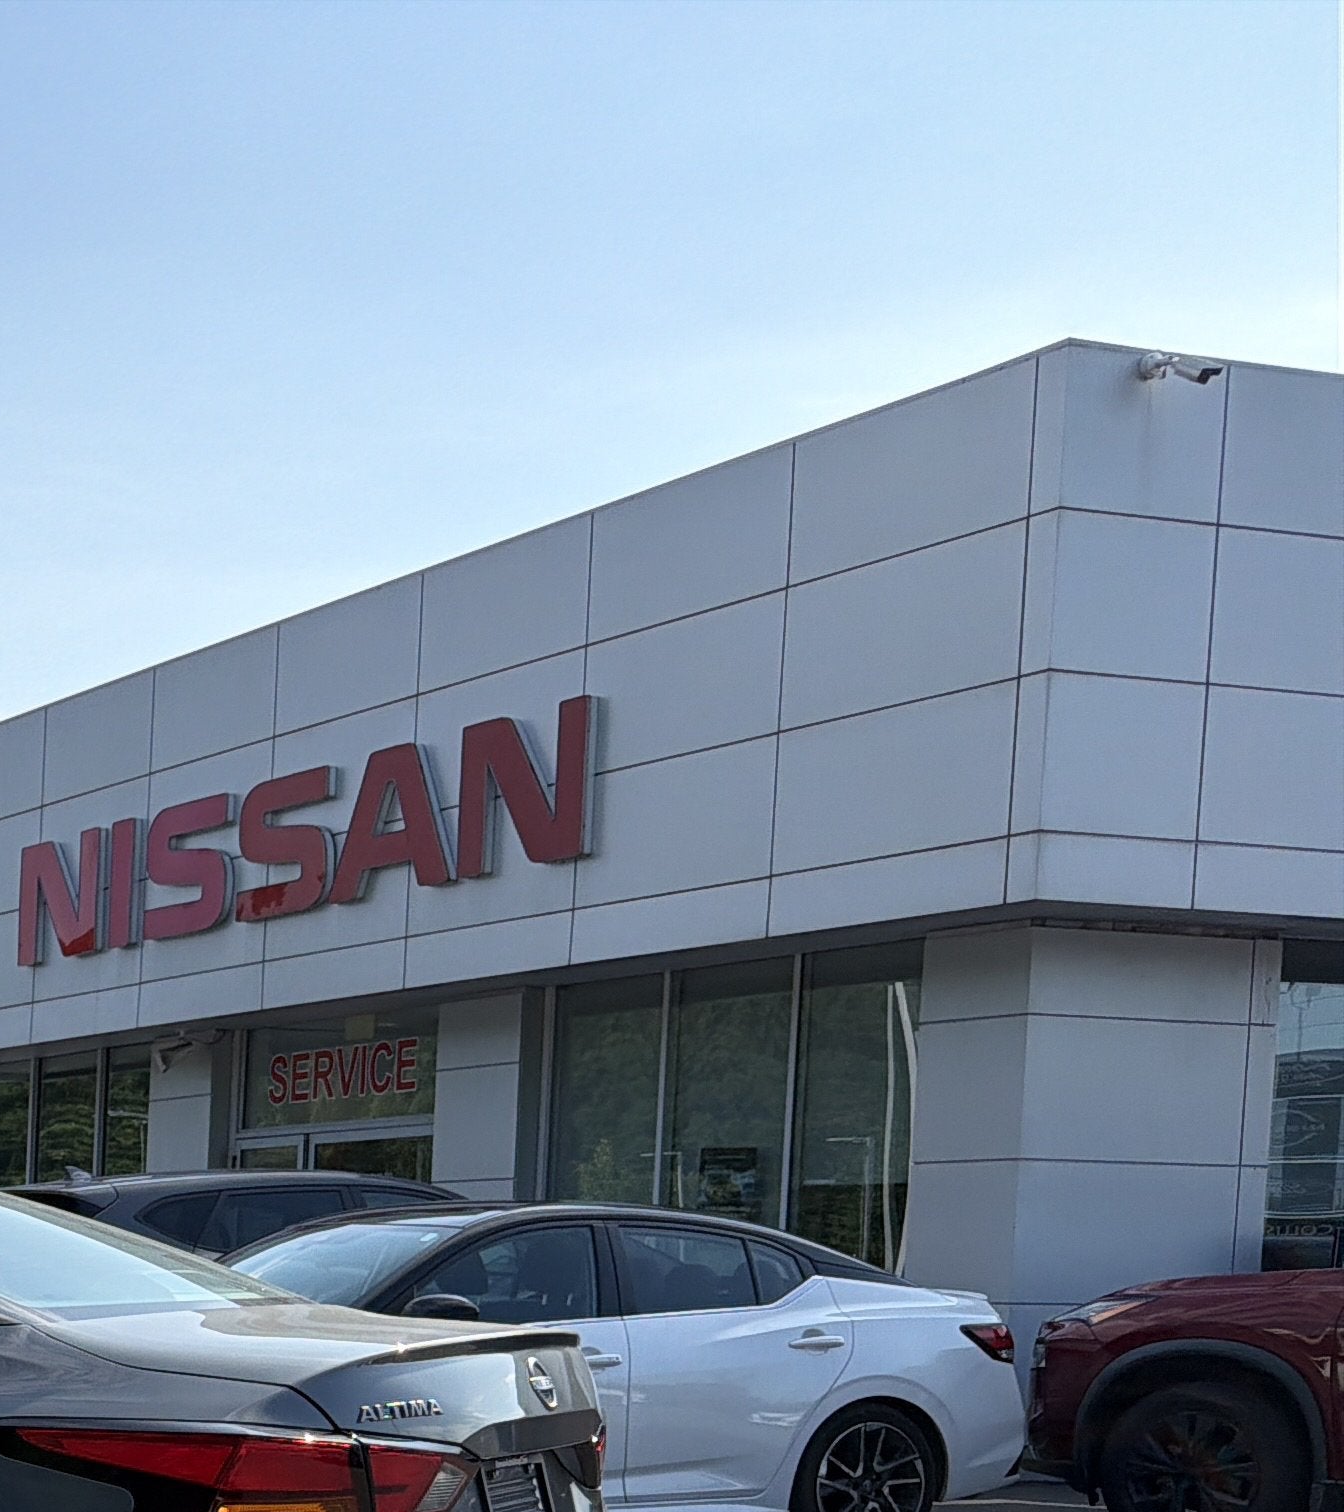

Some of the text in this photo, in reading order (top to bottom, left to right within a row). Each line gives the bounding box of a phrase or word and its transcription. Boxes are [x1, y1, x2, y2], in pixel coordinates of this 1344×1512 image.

[17, 694, 602, 967] NISSAN
[268, 1036, 419, 1106] SERVICE
[357, 1398, 444, 1424] ALTIMA
